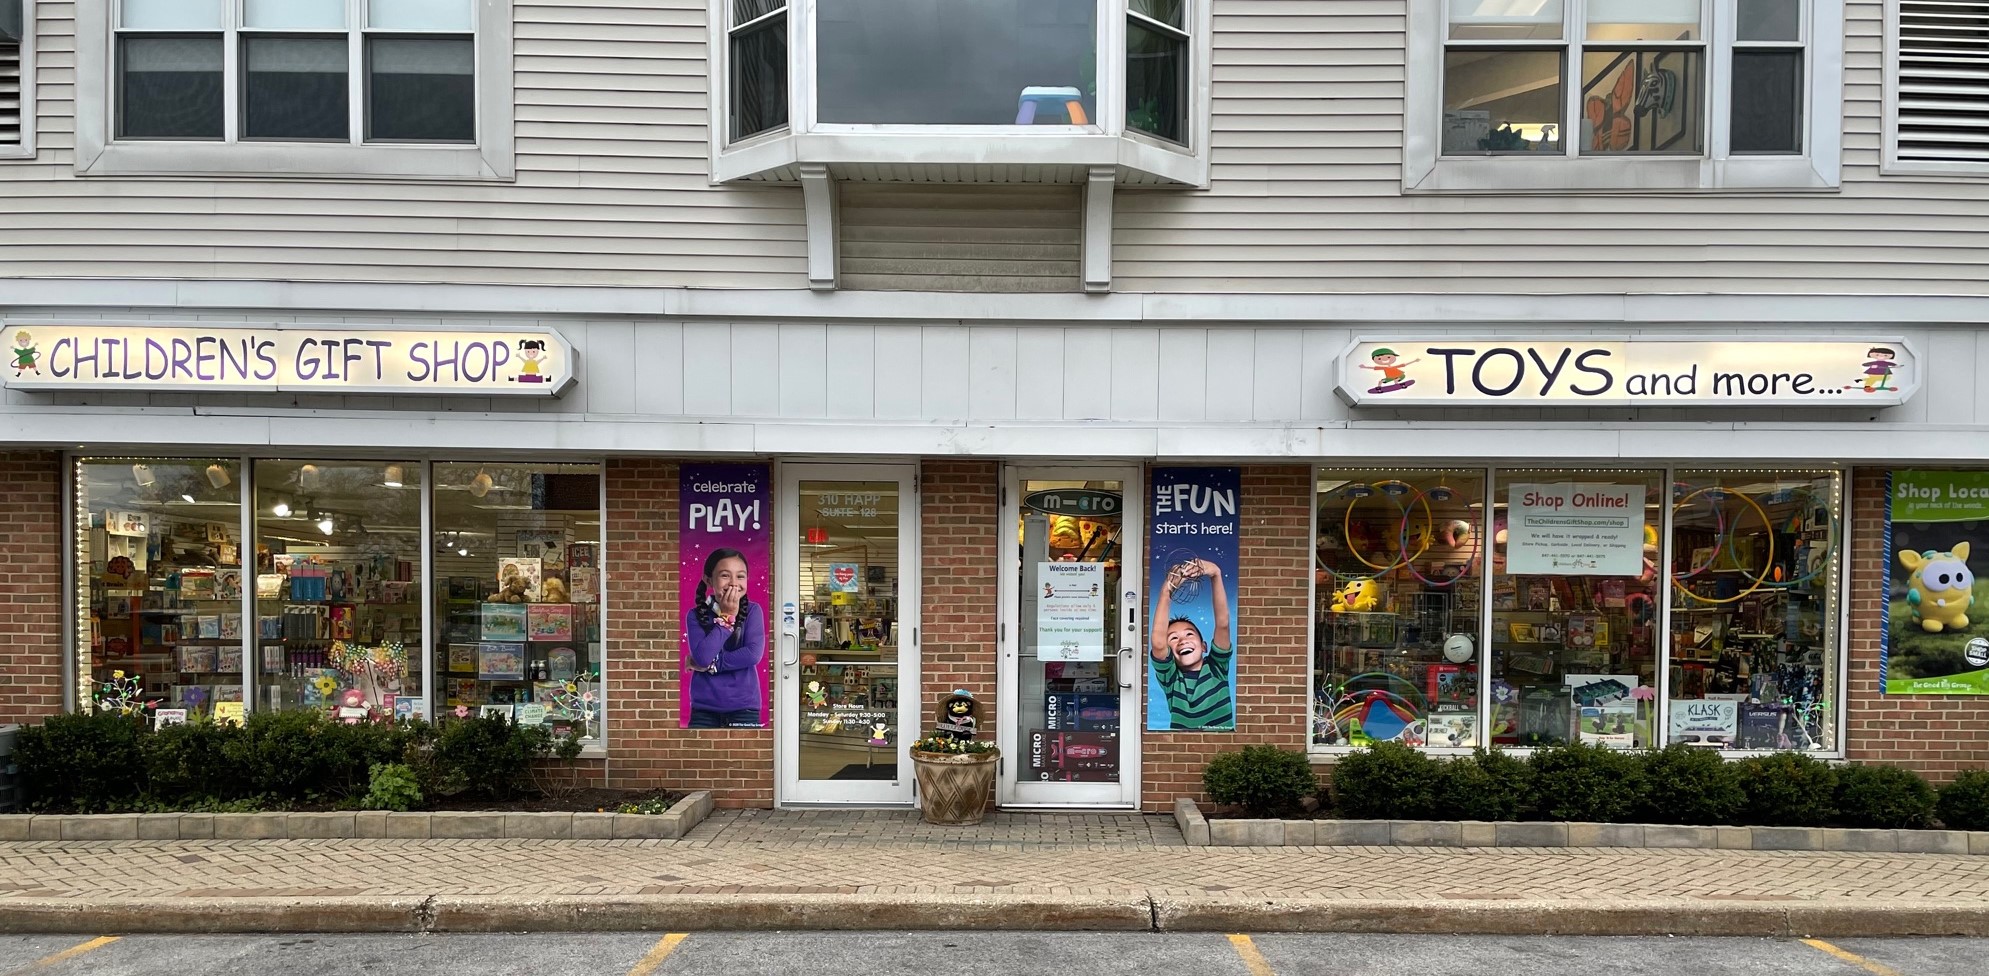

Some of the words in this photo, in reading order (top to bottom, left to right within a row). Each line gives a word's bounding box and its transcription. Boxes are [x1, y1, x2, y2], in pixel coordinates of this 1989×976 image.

[49, 335, 277, 381] CHILDREN'S
[295, 339, 392, 380] GIFT
[406, 340, 511, 383] SHOP
[1426, 346, 1614, 397] TOYS
[1625, 363, 1698, 396] and
[1712, 370, 1844, 397] more...
[693, 480, 756, 494] celebrate
[1897, 482, 1941, 503] Shop
[817, 494, 839, 506] 310
[844, 494, 881, 506] HAPP
[1155, 484, 1172, 516] THE
[1173, 483, 1236, 517] FUN
[1522, 491, 1564, 512] Shop
[1572, 492, 1629, 508] Online!
[689, 498, 761, 533] PLAY!
[859, 507, 877, 518] 128
[1155, 522, 1198, 535] starts
[1201, 522, 1233, 535] here!
[1047, 695, 1057, 730] MICRO
[1687, 704, 1721, 716] KLASK
[1032, 733, 1042, 768] MICRO
